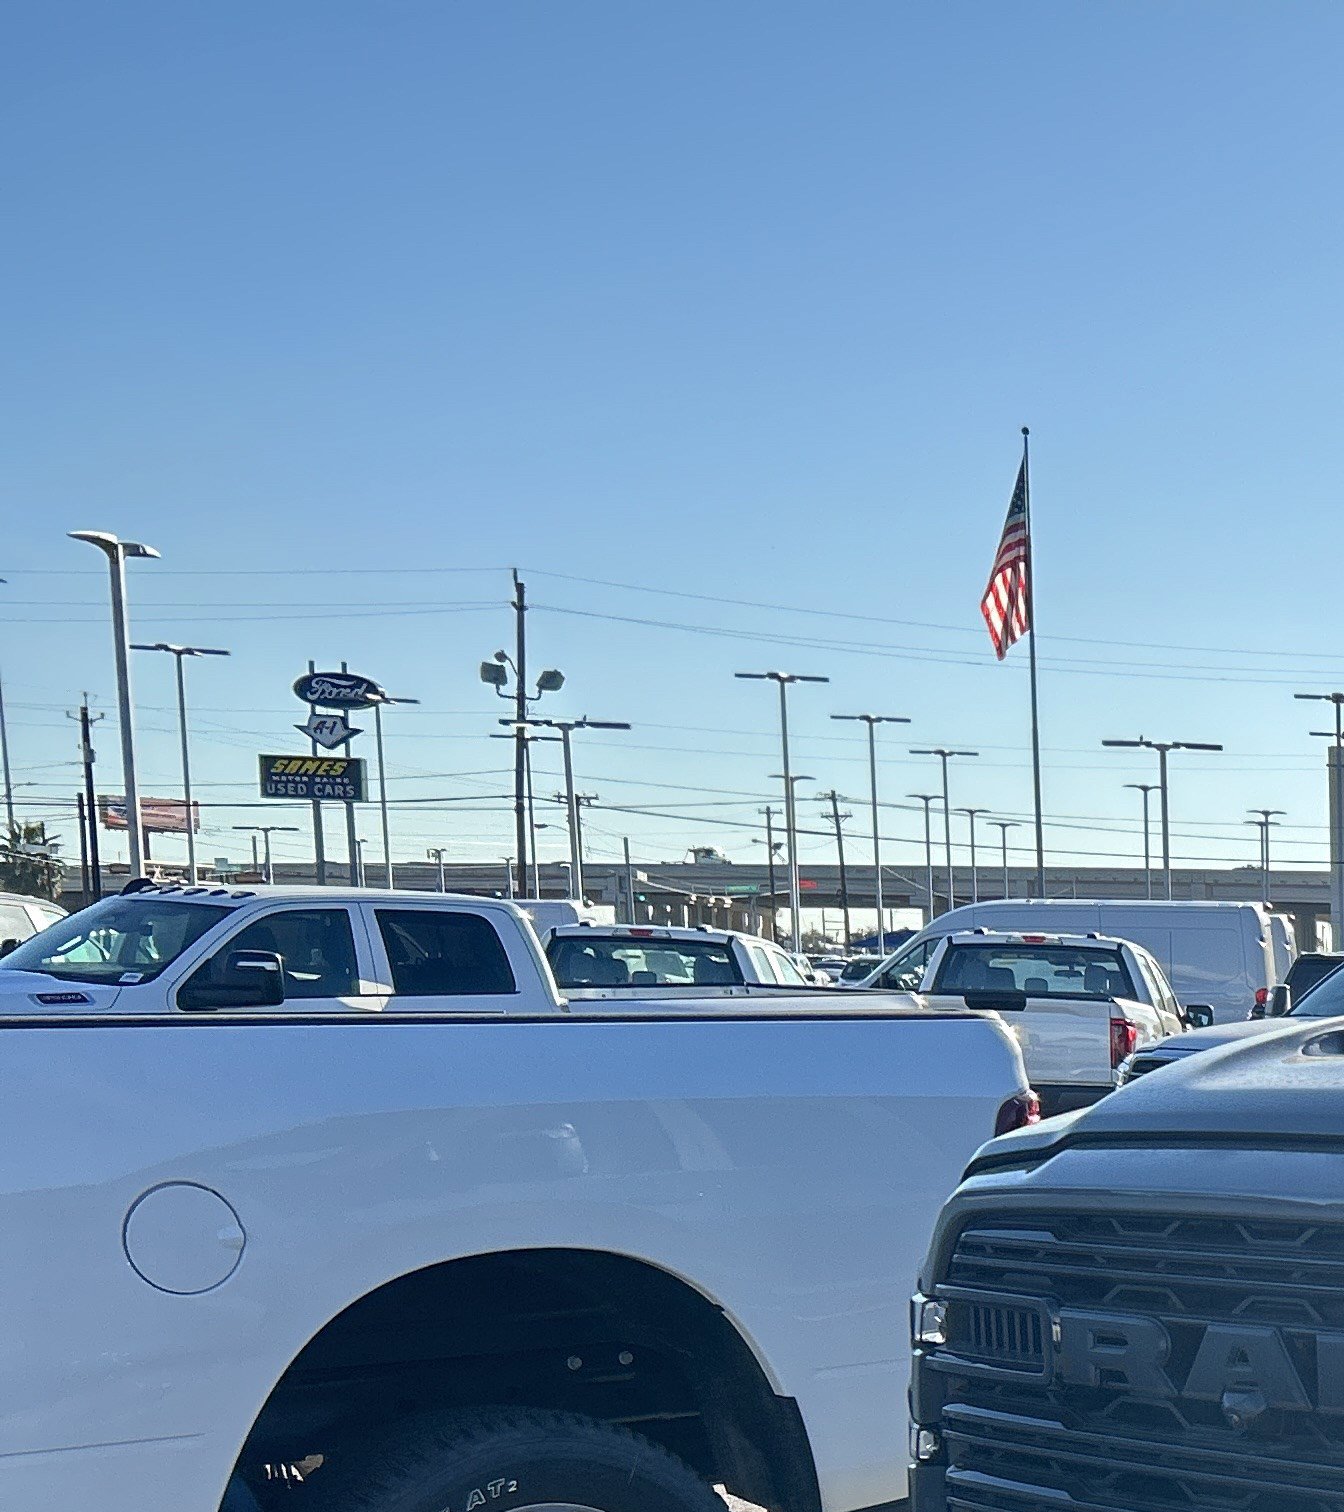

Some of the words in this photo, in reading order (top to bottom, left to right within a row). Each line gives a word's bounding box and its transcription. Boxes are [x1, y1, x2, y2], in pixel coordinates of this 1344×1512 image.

[306, 676, 368, 701] Ford
[270, 758, 348, 776] SAMES
[266, 782, 307, 796] USED
[313, 783, 355, 798] CARS
